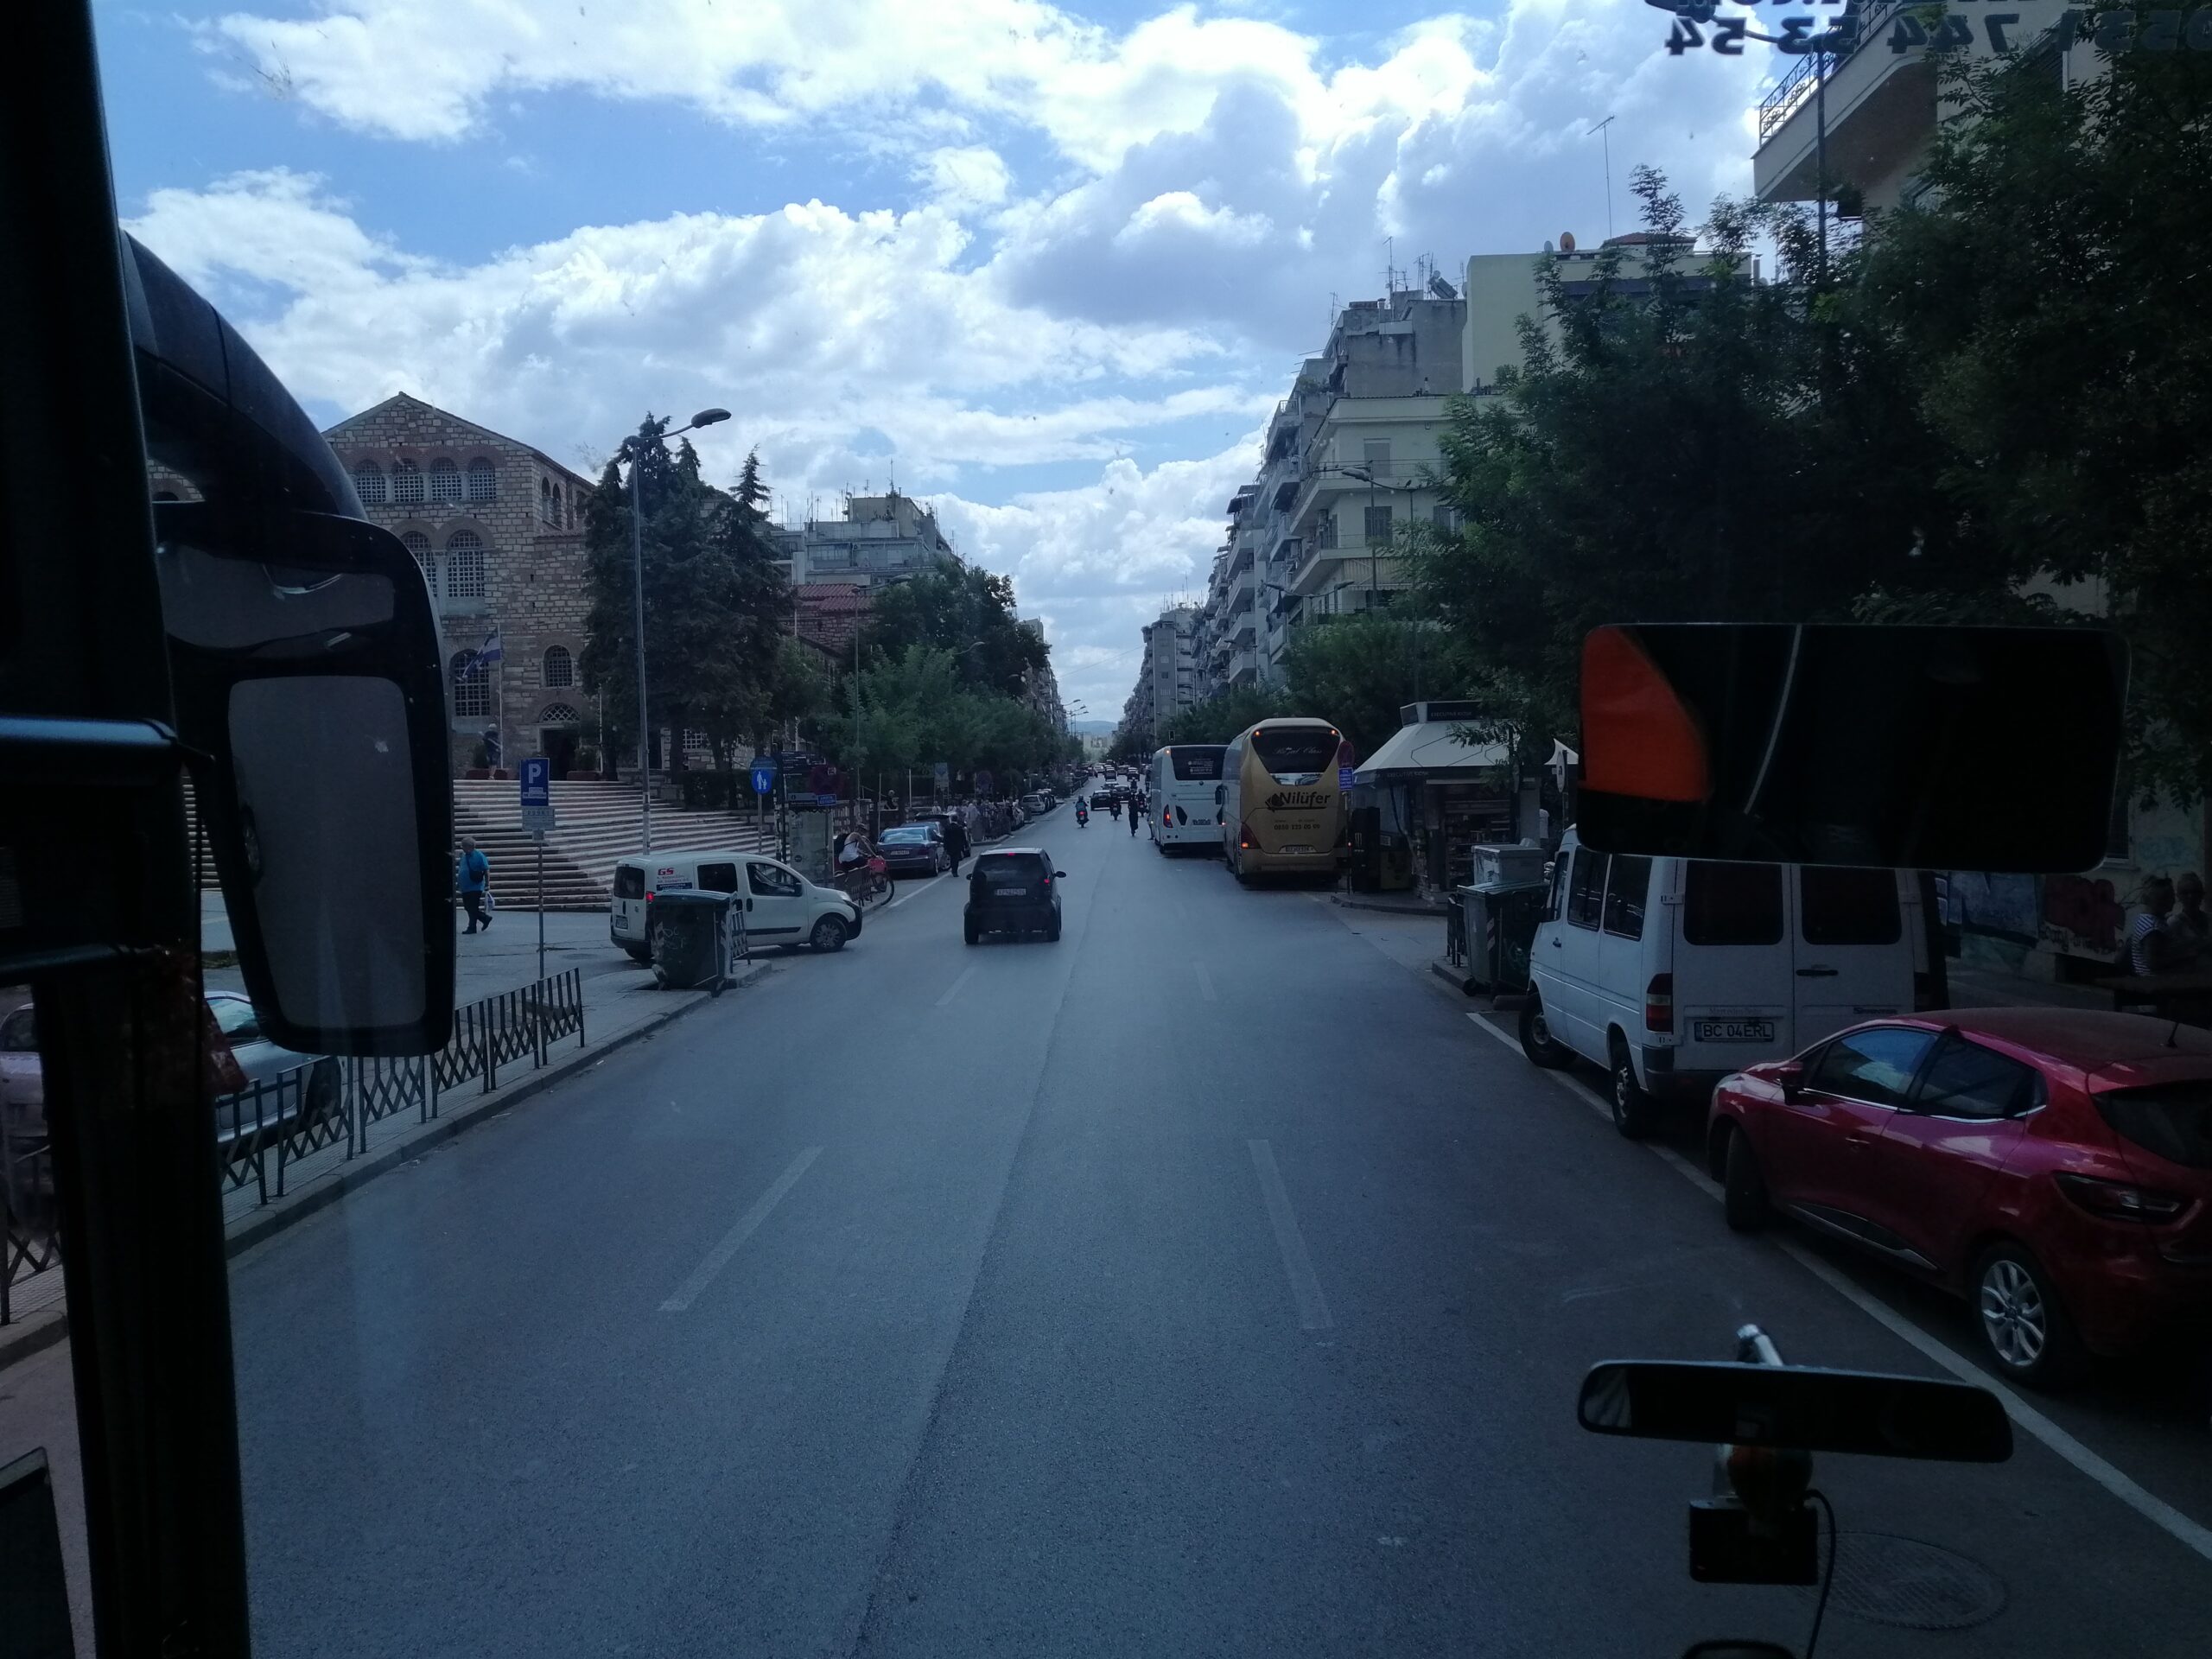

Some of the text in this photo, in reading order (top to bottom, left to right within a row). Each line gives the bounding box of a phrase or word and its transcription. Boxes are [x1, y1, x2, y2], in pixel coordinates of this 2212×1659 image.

[528, 763, 542, 784] P
[1279, 791, 1332, 808] Nilüfer
[658, 867, 675, 876] GS
[1702, 1024, 1770, 1038] BC 04ERL
